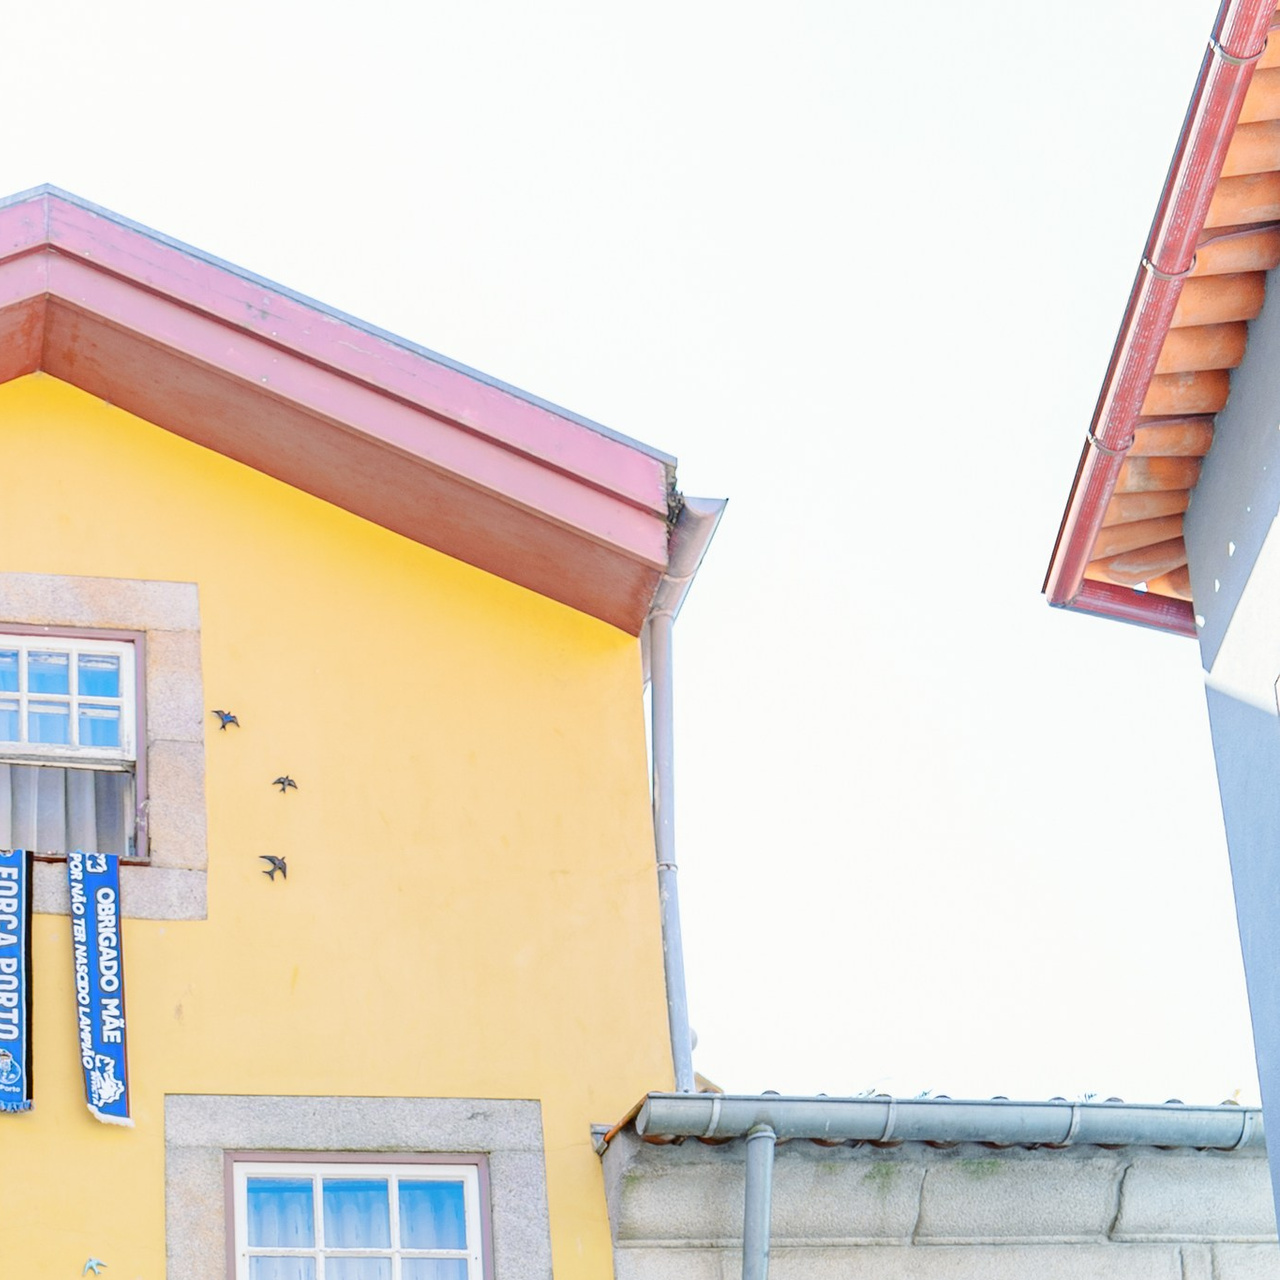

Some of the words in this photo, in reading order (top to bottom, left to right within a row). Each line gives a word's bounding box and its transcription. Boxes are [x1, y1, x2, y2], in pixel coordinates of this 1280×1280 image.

[69, 853, 84, 880] POR
[71, 882, 87, 915] NÃO
[73, 918, 87, 943] TER
[96, 887, 119, 992] OBRIGADO
[79, 1006, 95, 1070] LAMPIÃO
[101, 998, 125, 1043] MÃE
